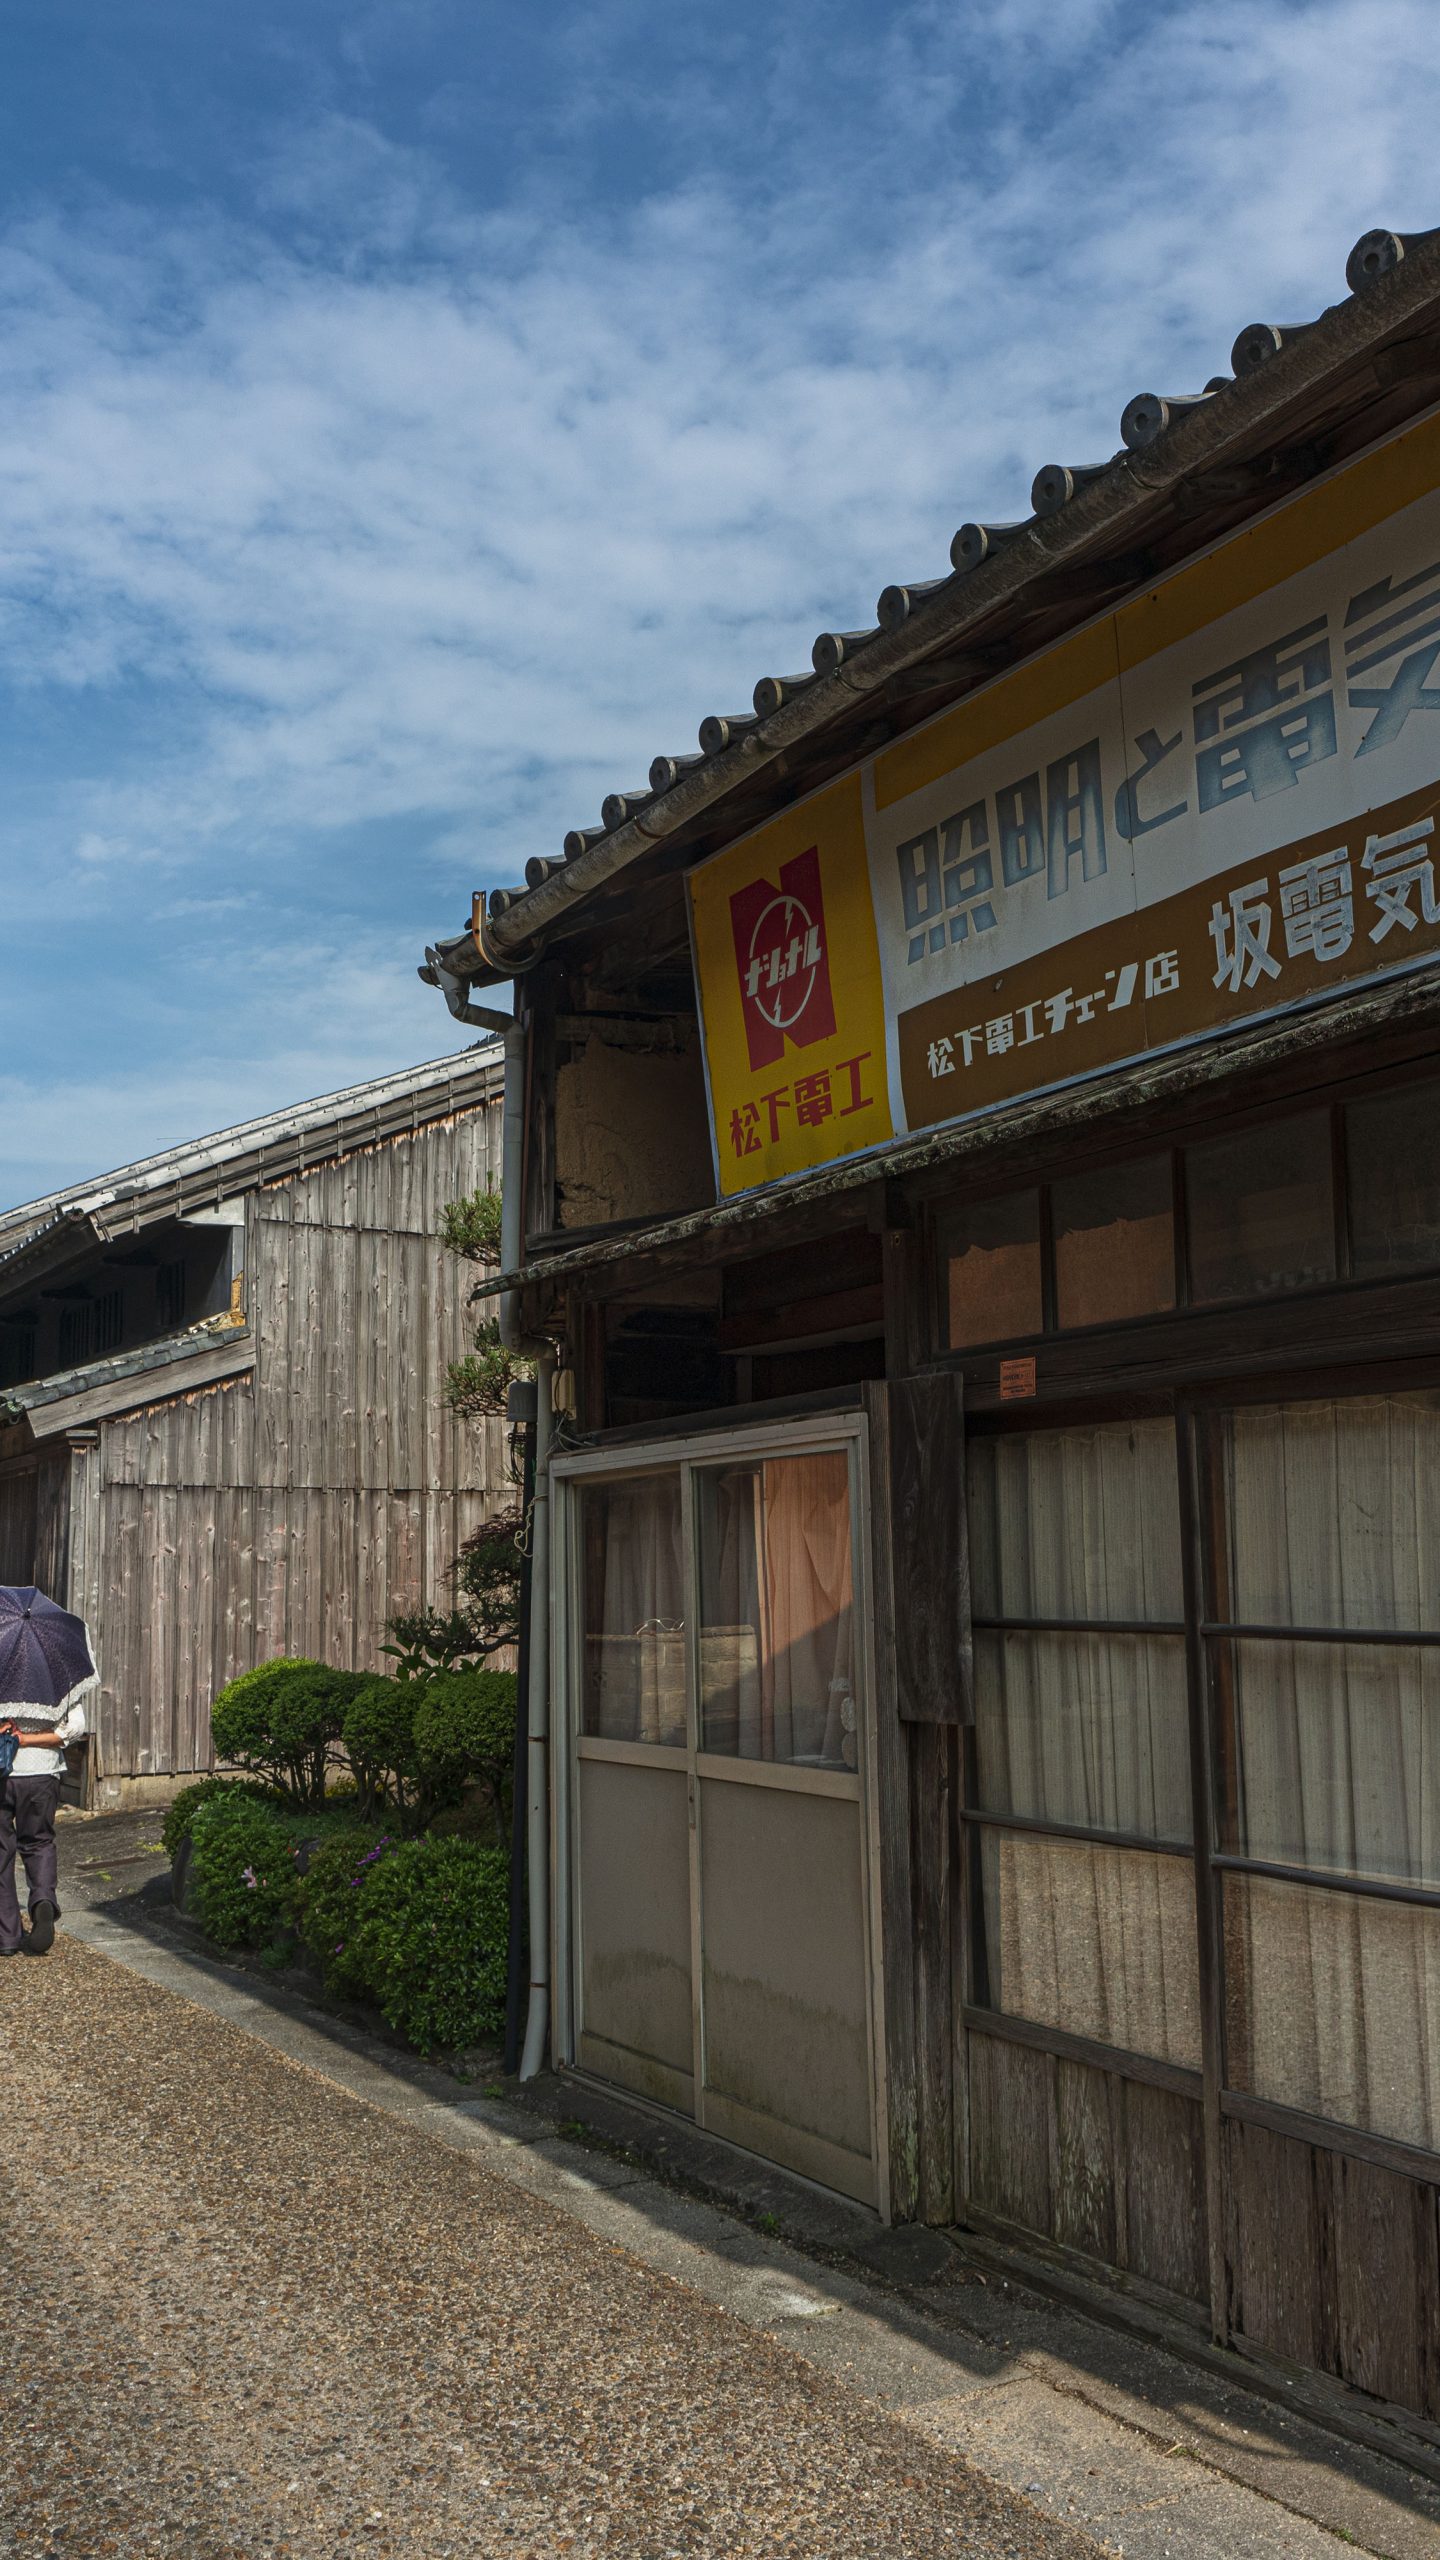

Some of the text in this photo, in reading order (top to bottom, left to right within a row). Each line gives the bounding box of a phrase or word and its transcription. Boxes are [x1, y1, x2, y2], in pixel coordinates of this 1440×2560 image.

[744, 925, 822, 997] ナショナル
[1208, 816, 1440, 993] 坂電気
[927, 949, 1181, 1078] 松下電工チェーン店
[730, 1051, 874, 1158] 松下電工
